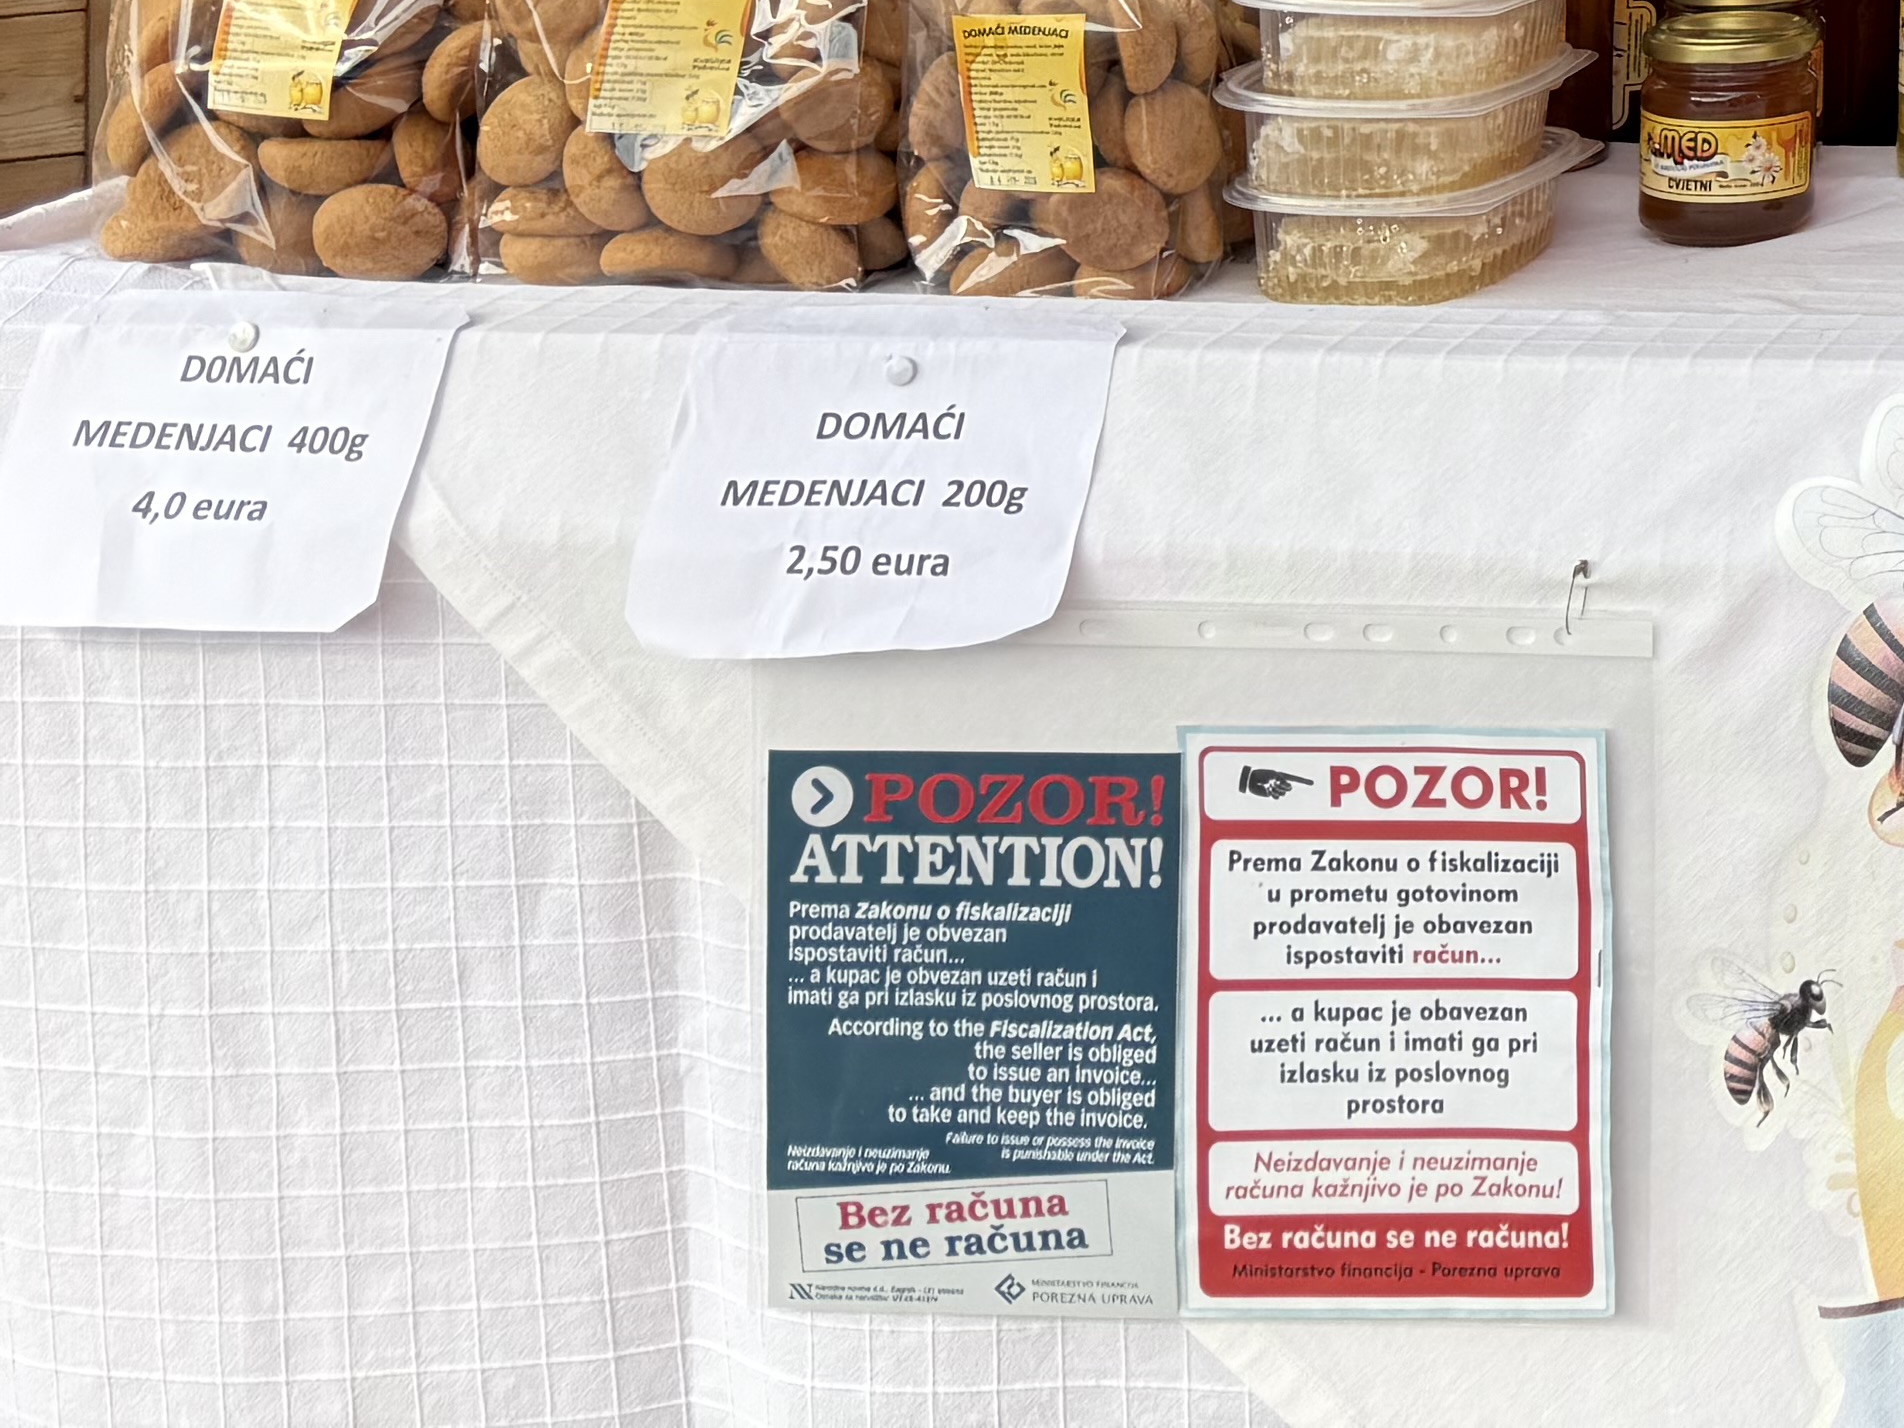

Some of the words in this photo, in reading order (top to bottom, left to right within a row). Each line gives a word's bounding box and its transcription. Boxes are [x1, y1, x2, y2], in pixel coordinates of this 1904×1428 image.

[1660, 129, 1719, 165] MED
[1667, 176, 1712, 192] CVJETNI
[816, 403, 966, 441] DOMAĆI
[72, 419, 273, 453] MEDENJACI
[286, 425, 370, 463] 400g
[131, 490, 188, 525] 4,0
[191, 497, 268, 522] eura
[720, 478, 926, 507] MEDENJACI
[941, 478, 1029, 515] 200g
[786, 544, 863, 581] 2,50
[871, 552, 950, 577] eura
[863, 772, 1165, 827] POZOR!
[1329, 765, 1548, 811] POZOR!
[789, 833, 1164, 889] ATTENTION!
[1228, 849, 1301, 873] Prema
[1310, 849, 1398, 873] Zakonu
[1406, 856, 1420, 873] o
[1429, 849, 1560, 878] fiskalizaciji
[836, 1199, 912, 1231] Bez
[925, 1191, 1070, 1226] računa
[823, 1238, 867, 1265] se
[880, 1234, 931, 1262] ne
[944, 1223, 1090, 1259] računa
[1223, 1224, 1273, 1250] Bez
[1281, 1223, 1377, 1250] računa
[1386, 1229, 1415, 1250] se
[1424, 1229, 1458, 1250] ne
[1466, 1221, 1571, 1250] računa!
